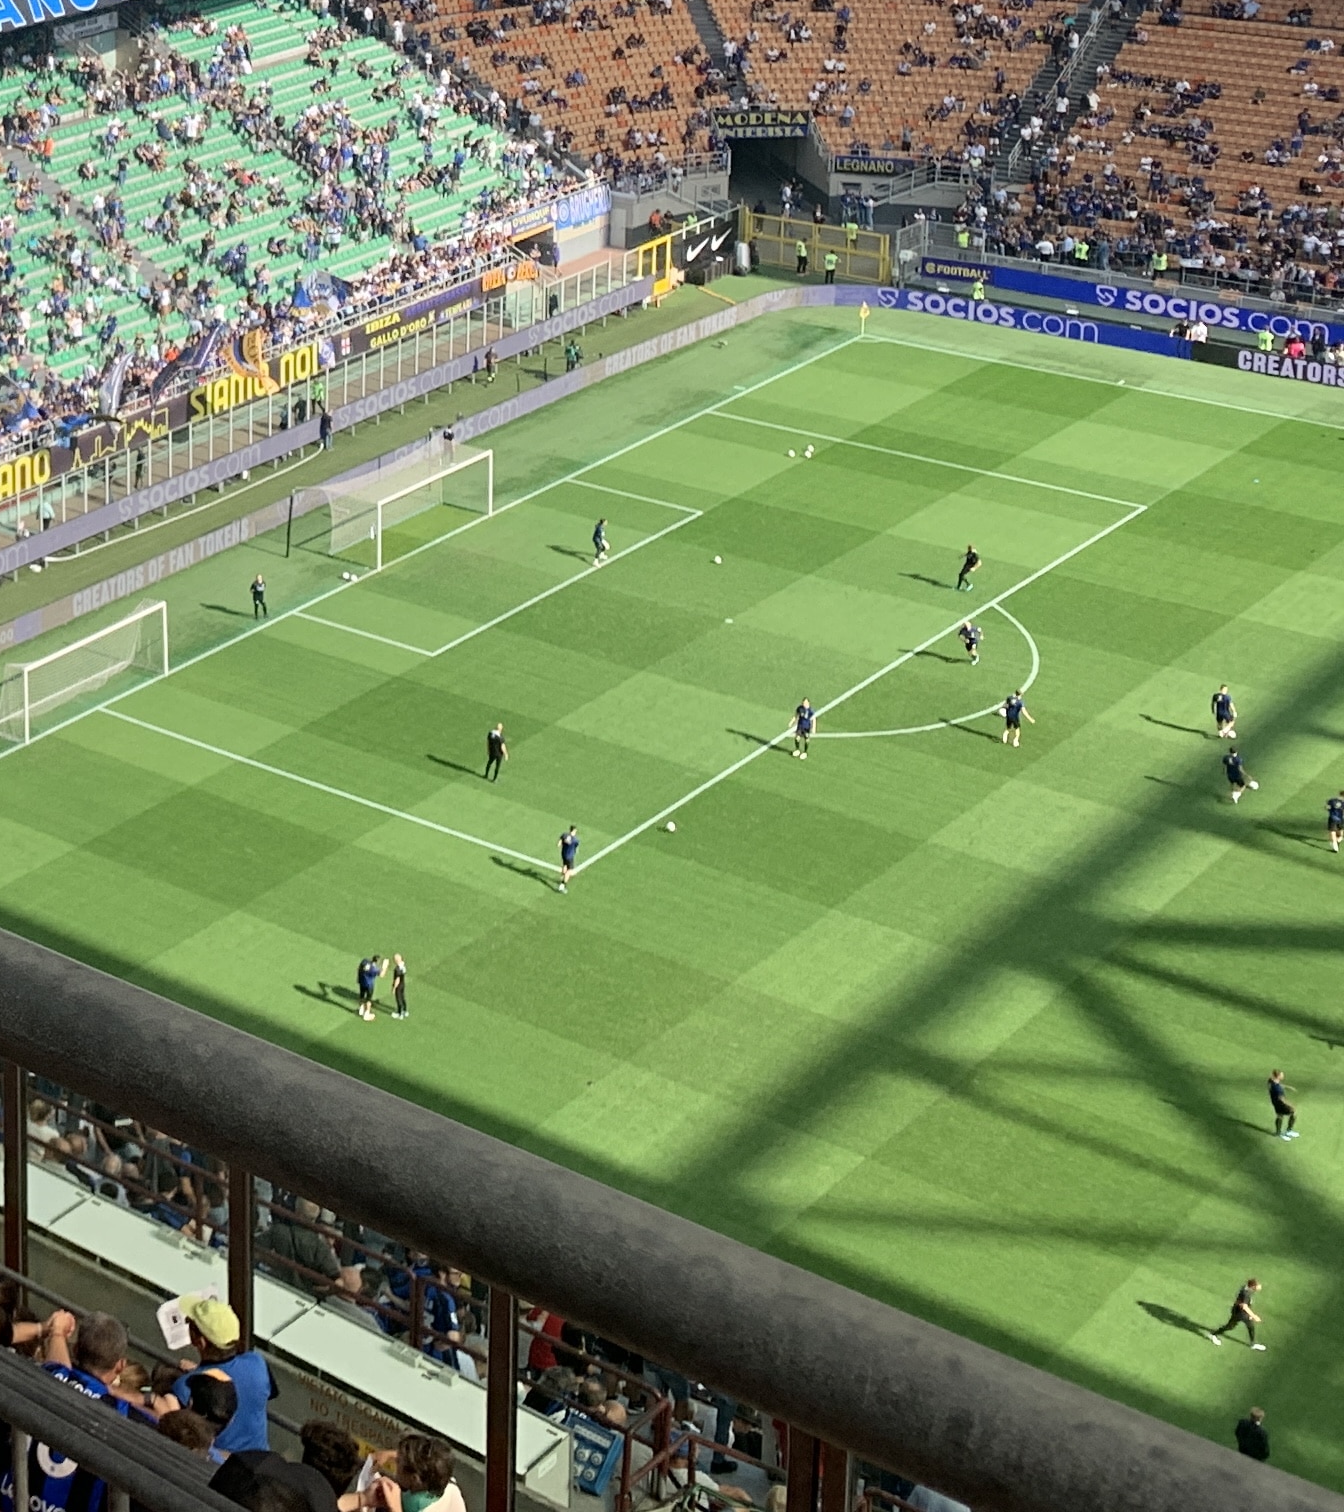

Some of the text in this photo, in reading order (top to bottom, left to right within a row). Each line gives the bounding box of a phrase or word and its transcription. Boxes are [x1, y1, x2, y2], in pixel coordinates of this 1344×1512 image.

[717, 111, 807, 127] MODENA
[719, 126, 805, 138] INTERISTA
[836, 159, 895, 174] LEGNANO
[365, 311, 401, 335] IBIZA
[369, 317, 428, 350] GALLO D'ORO
[907, 290, 1099, 344] SOCIOS.com
[1125, 288, 1330, 344] SOCIOS.com
[279, 341, 319, 389] NOI
[73, 518, 250, 618] CREATORS OF FAN TOKENS
[0, 1472, 67, 1512] Leov
